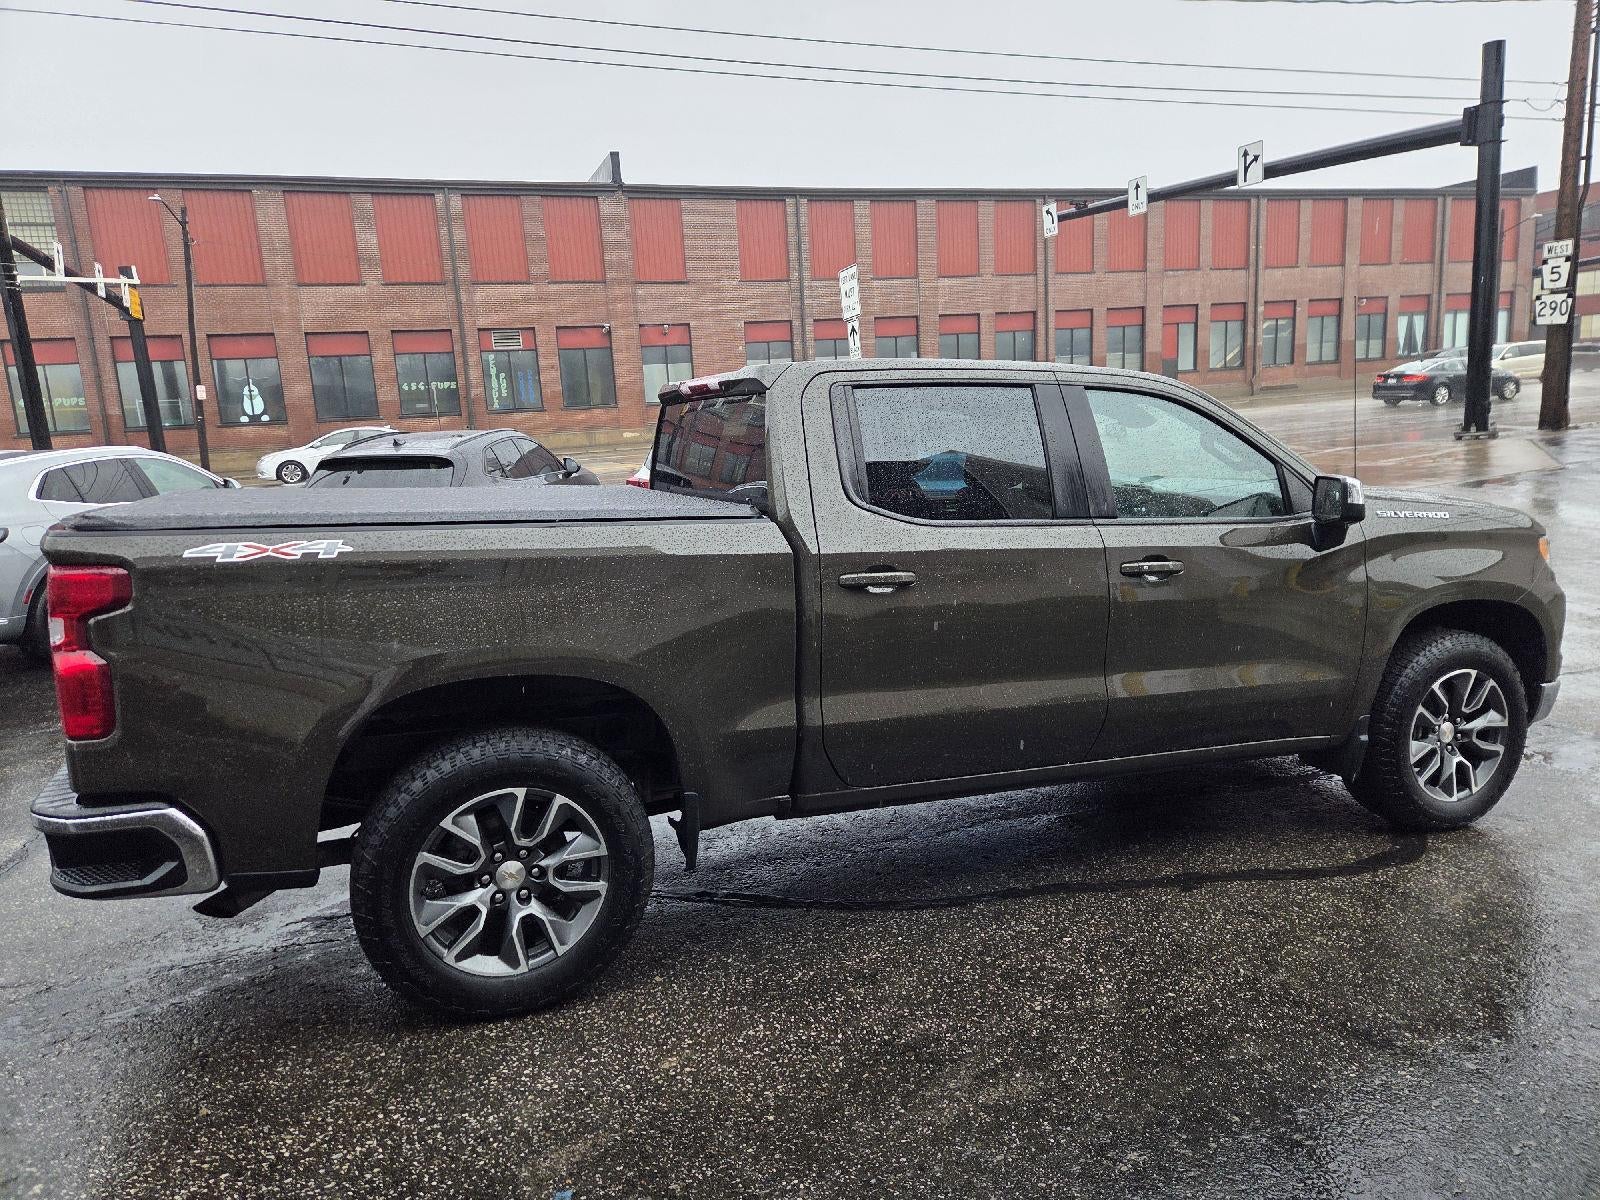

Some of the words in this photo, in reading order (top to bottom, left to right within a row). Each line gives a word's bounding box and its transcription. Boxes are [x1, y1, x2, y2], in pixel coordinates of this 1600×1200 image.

[1547, 244, 1569, 254] WEST
[1549, 265, 1562, 282] 5
[1537, 299, 1569, 317] 290
[1376, 510, 1450, 519] SILVERADO
